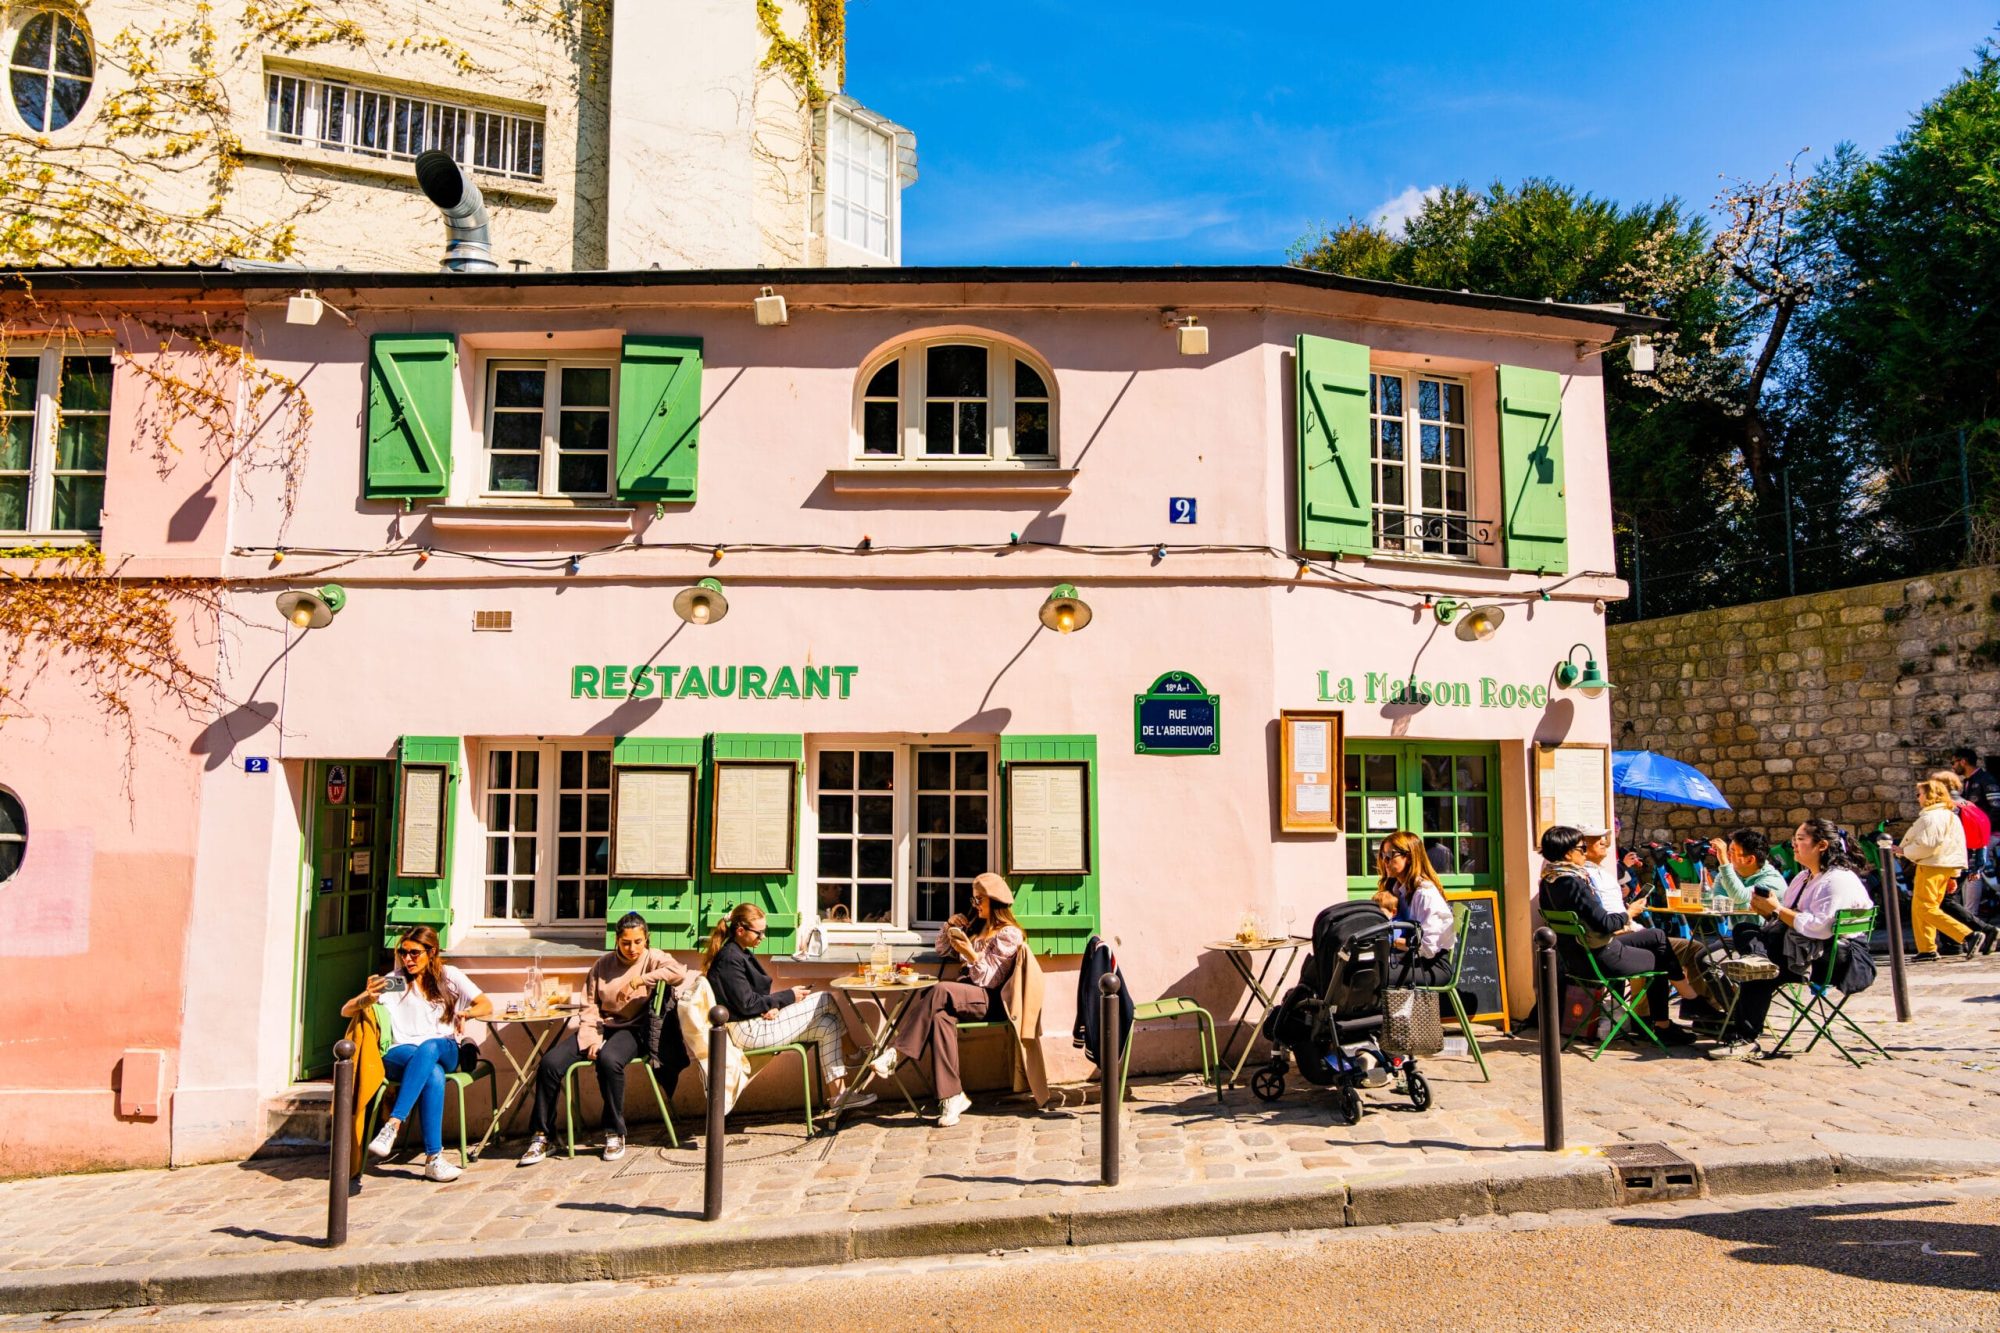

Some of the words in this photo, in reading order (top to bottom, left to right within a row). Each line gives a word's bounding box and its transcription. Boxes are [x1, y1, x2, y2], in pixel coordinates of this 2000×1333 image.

[1175, 499, 1190, 523] 2
[571, 665, 858, 699] RESTAURANT
[1317, 669, 1355, 703] La
[1364, 672, 1472, 707] Maison
[1479, 677, 1547, 708] Rose
[1168, 709, 1187, 719] RUE
[1143, 726, 1154, 736] DE
[1156, 725, 1214, 736] L'ABREUVOIR
[251, 759, 261, 772] 2
